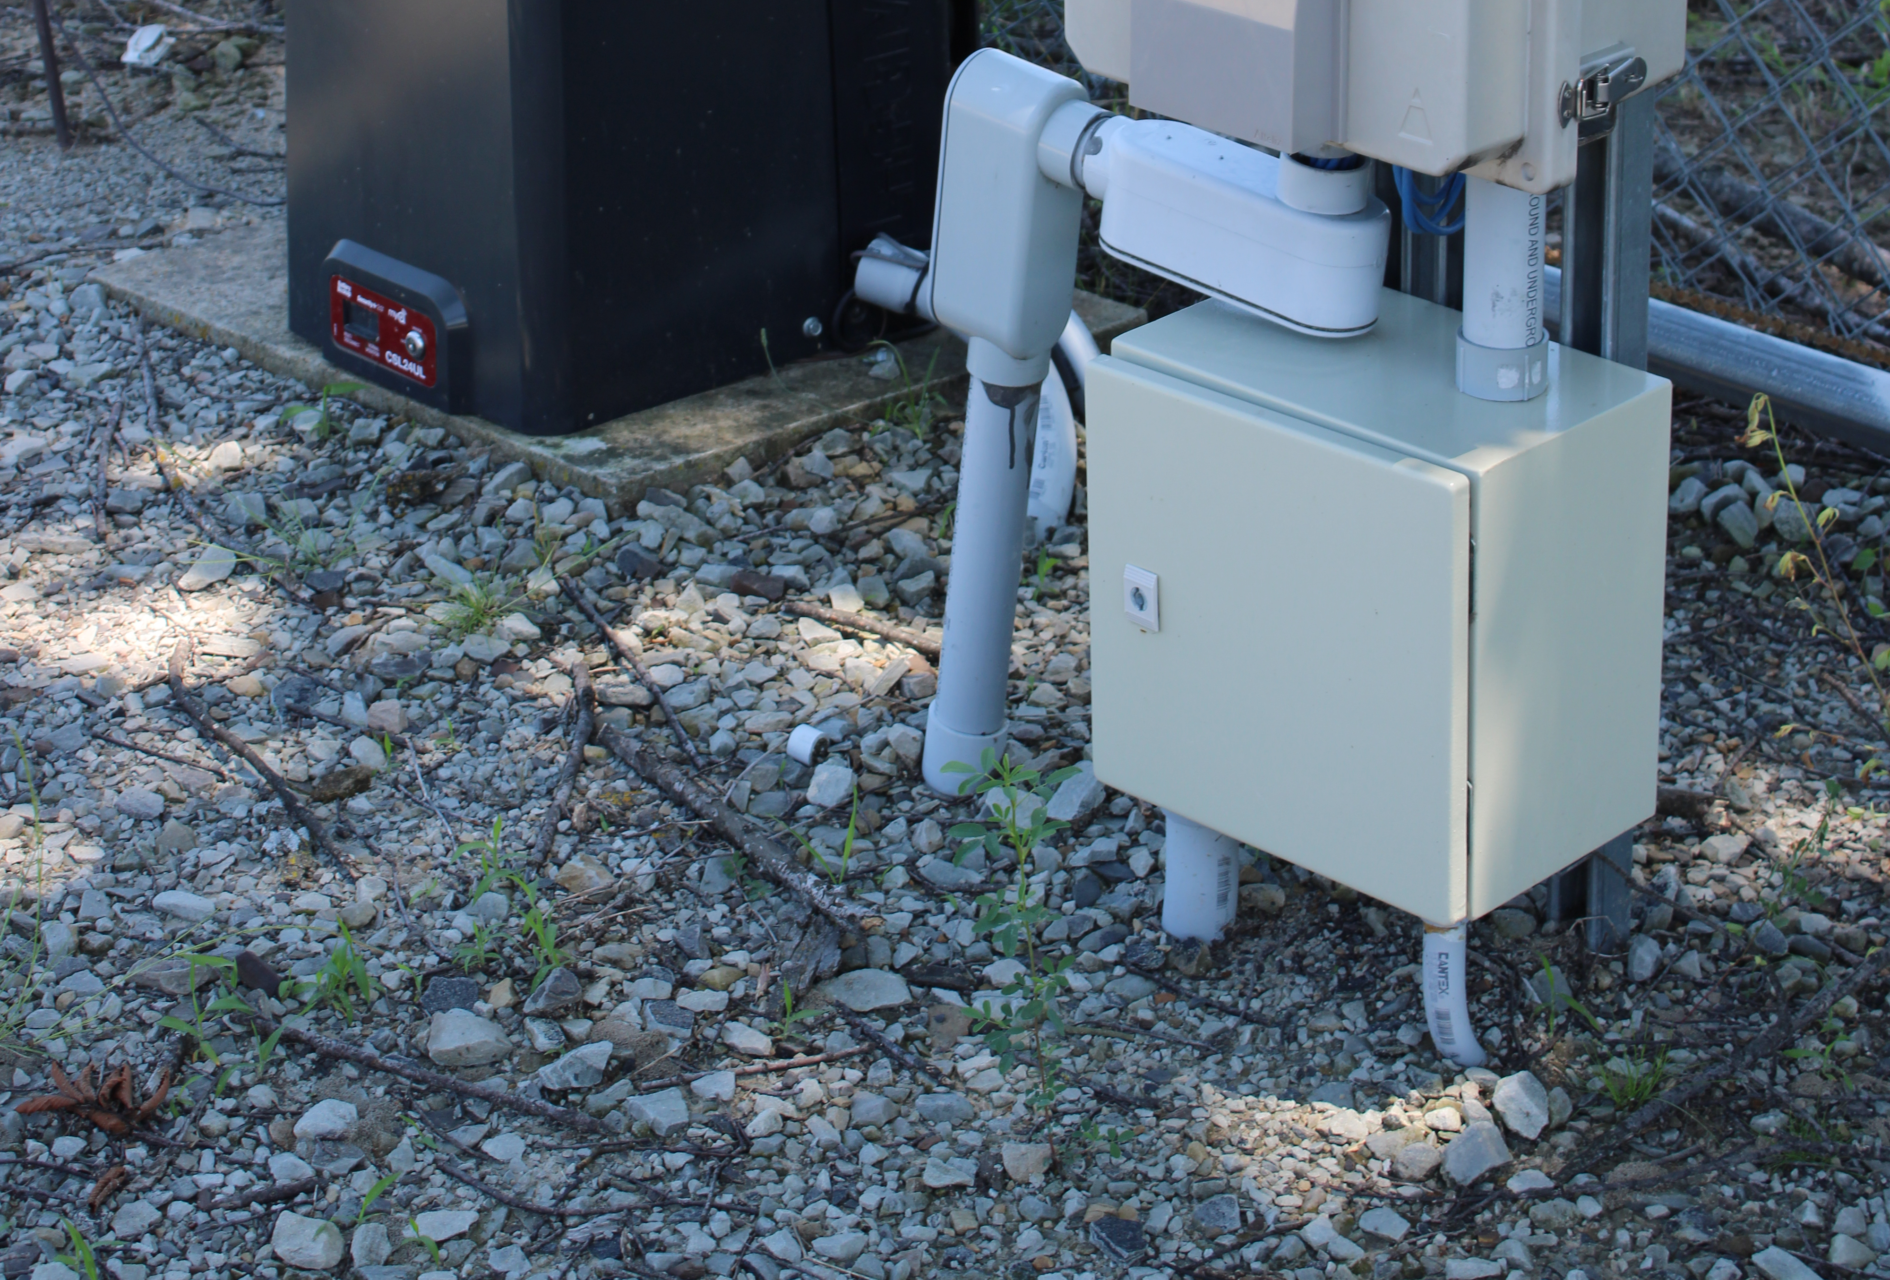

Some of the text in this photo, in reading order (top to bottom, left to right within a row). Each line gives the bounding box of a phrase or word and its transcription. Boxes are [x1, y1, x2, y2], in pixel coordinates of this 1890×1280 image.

[1528, 194, 1540, 237] OUND
[1527, 239, 1539, 267] AND
[385, 350, 427, 380] CSL24UL
[1438, 952, 1449, 995] CANTEX
